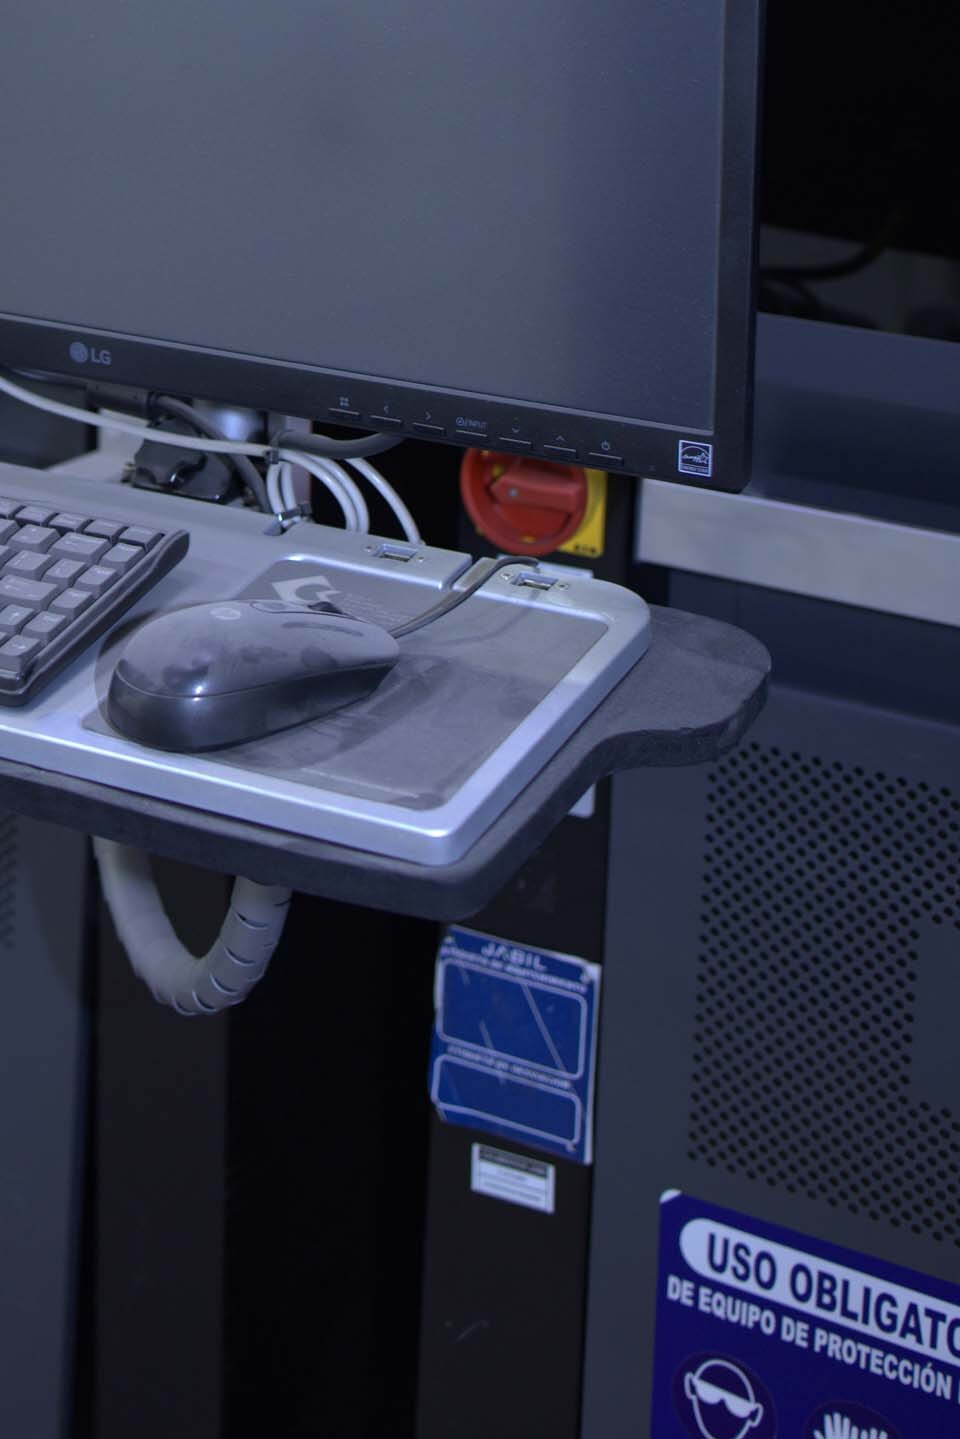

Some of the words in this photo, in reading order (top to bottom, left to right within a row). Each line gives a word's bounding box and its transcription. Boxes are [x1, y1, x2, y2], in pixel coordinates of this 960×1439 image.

[667, 1274, 694, 1307] DE
[698, 1287, 776, 1336] EQUIPO
[781, 1316, 810, 1348] DE
[814, 1329, 952, 1399] PROTECCIÓN
[708, 1232, 777, 1291] USO
[790, 1263, 960, 1363] OBLIGATO
